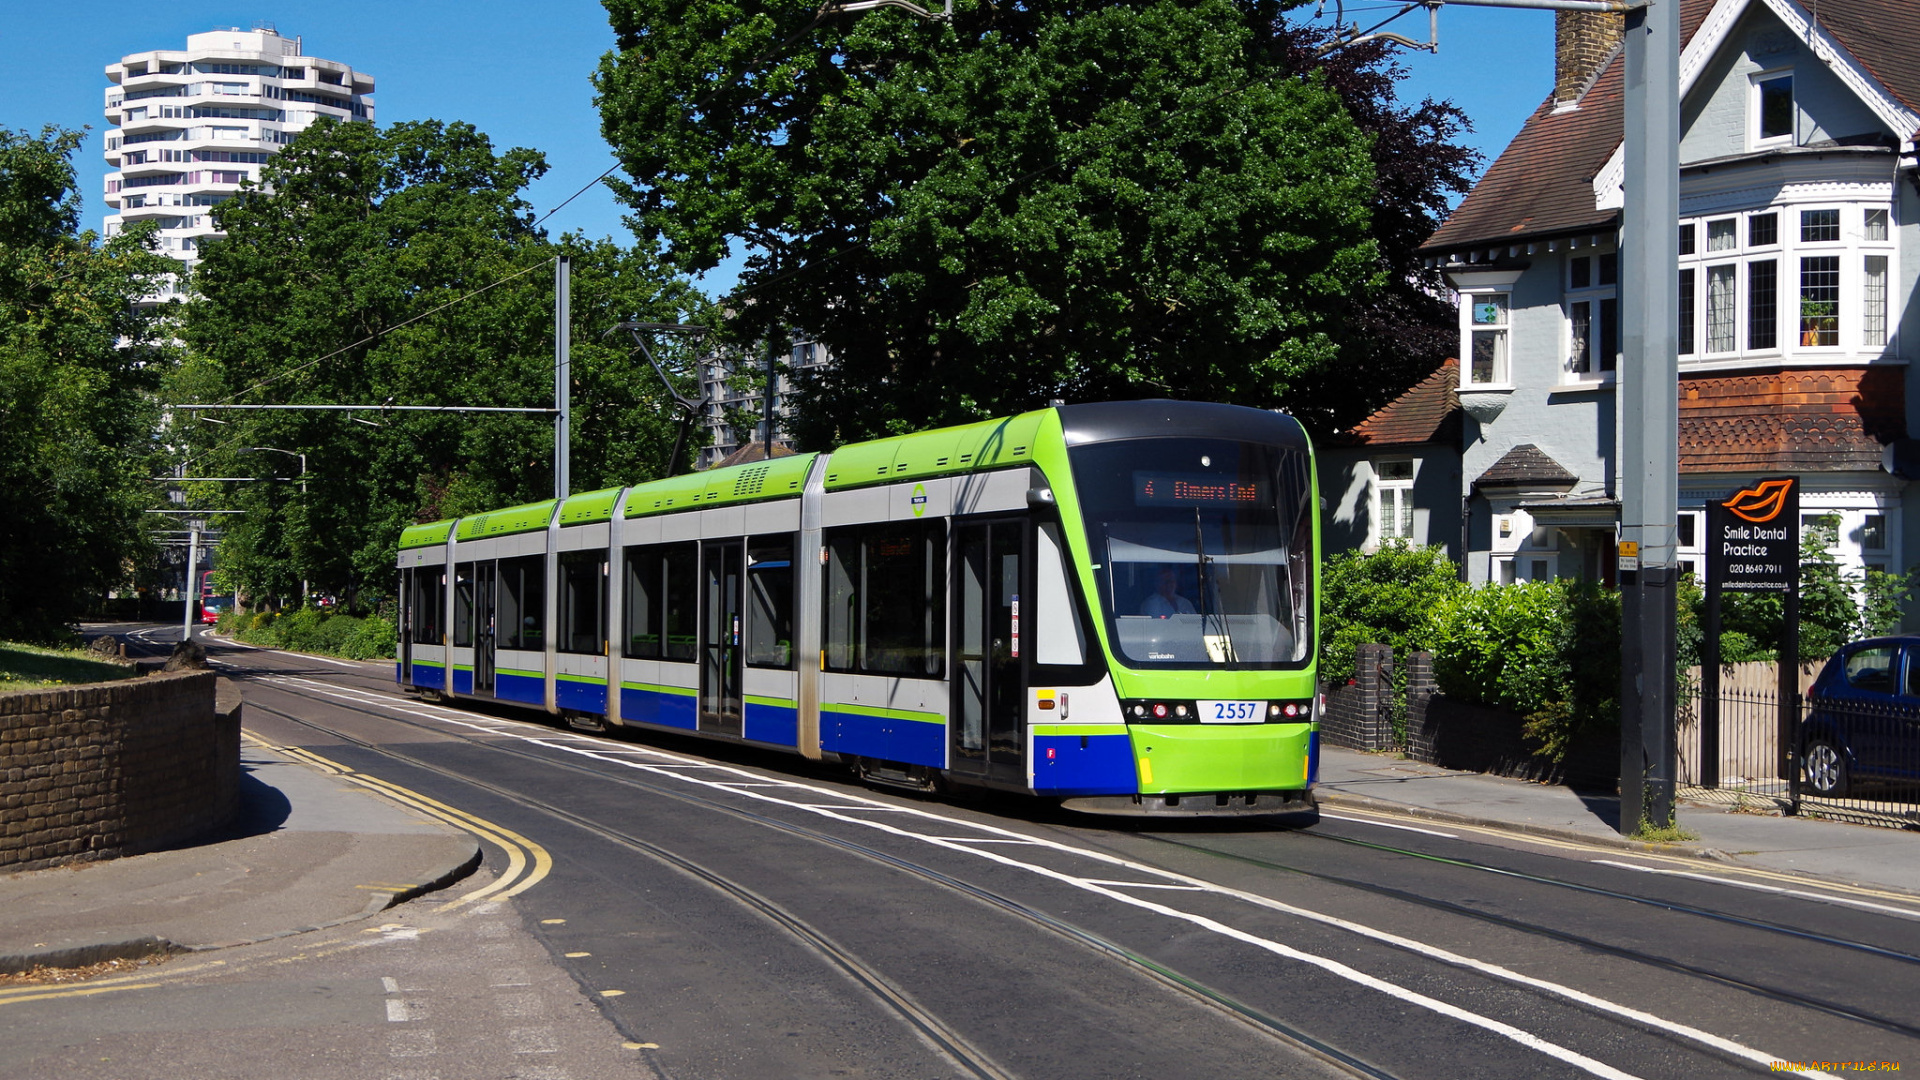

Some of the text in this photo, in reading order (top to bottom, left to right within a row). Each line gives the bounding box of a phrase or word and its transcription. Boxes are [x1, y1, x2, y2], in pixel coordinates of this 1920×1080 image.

[1145, 481, 1256, 501] 4 Elmers End
[1724, 525, 1787, 540] Smile Dental
[1723, 542, 1768, 556] Practice
[1729, 564, 1782, 574] 020 8649 7911
[1215, 703, 1256, 719] 2557
